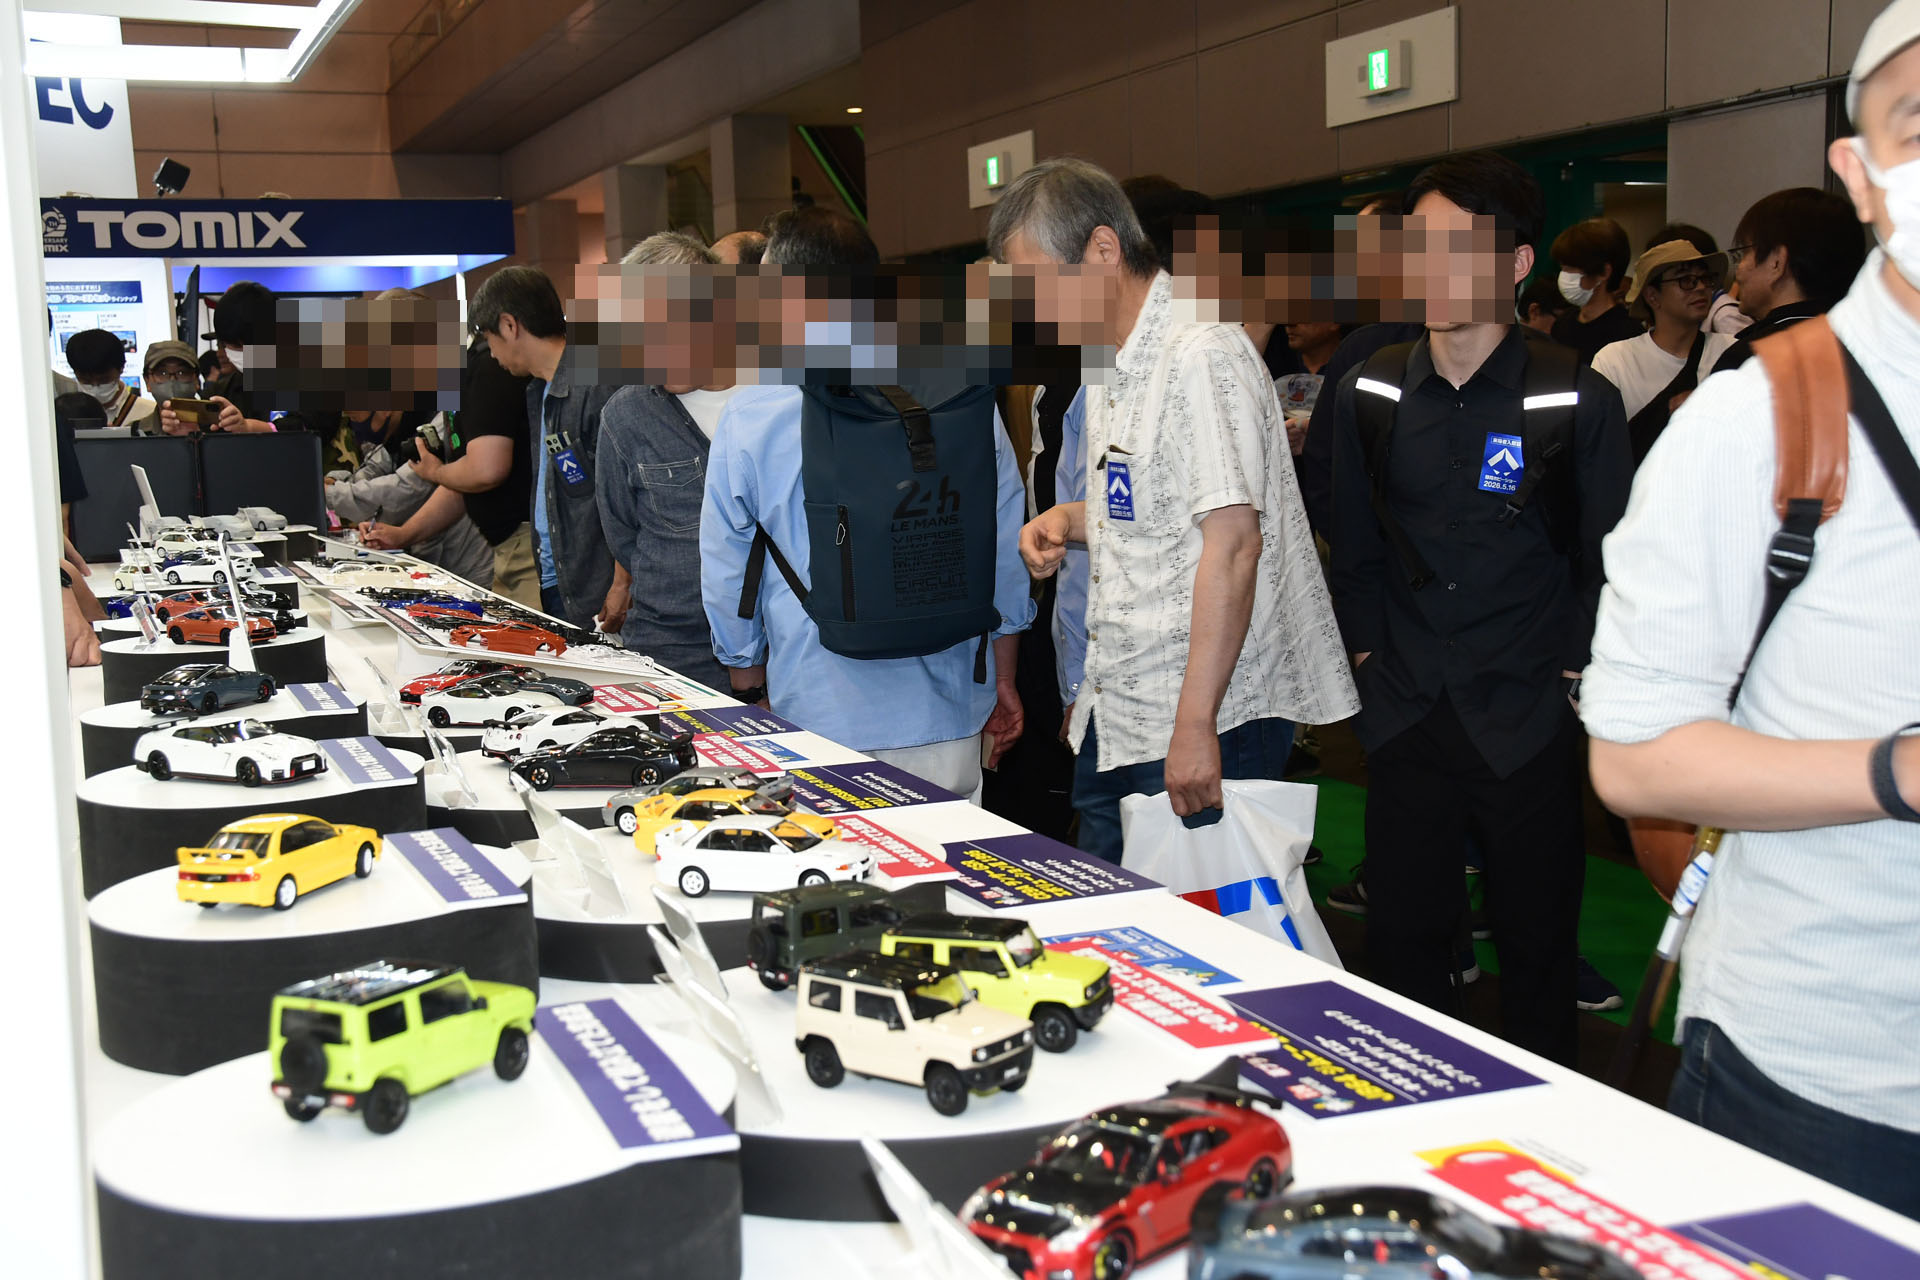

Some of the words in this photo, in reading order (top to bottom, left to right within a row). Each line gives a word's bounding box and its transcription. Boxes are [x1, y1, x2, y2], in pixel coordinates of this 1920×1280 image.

[77, 210, 307, 249] TOMIX
[44, 244, 69, 253] MIX
[891, 520, 910, 533] LE
[913, 514, 961, 530] MANS
